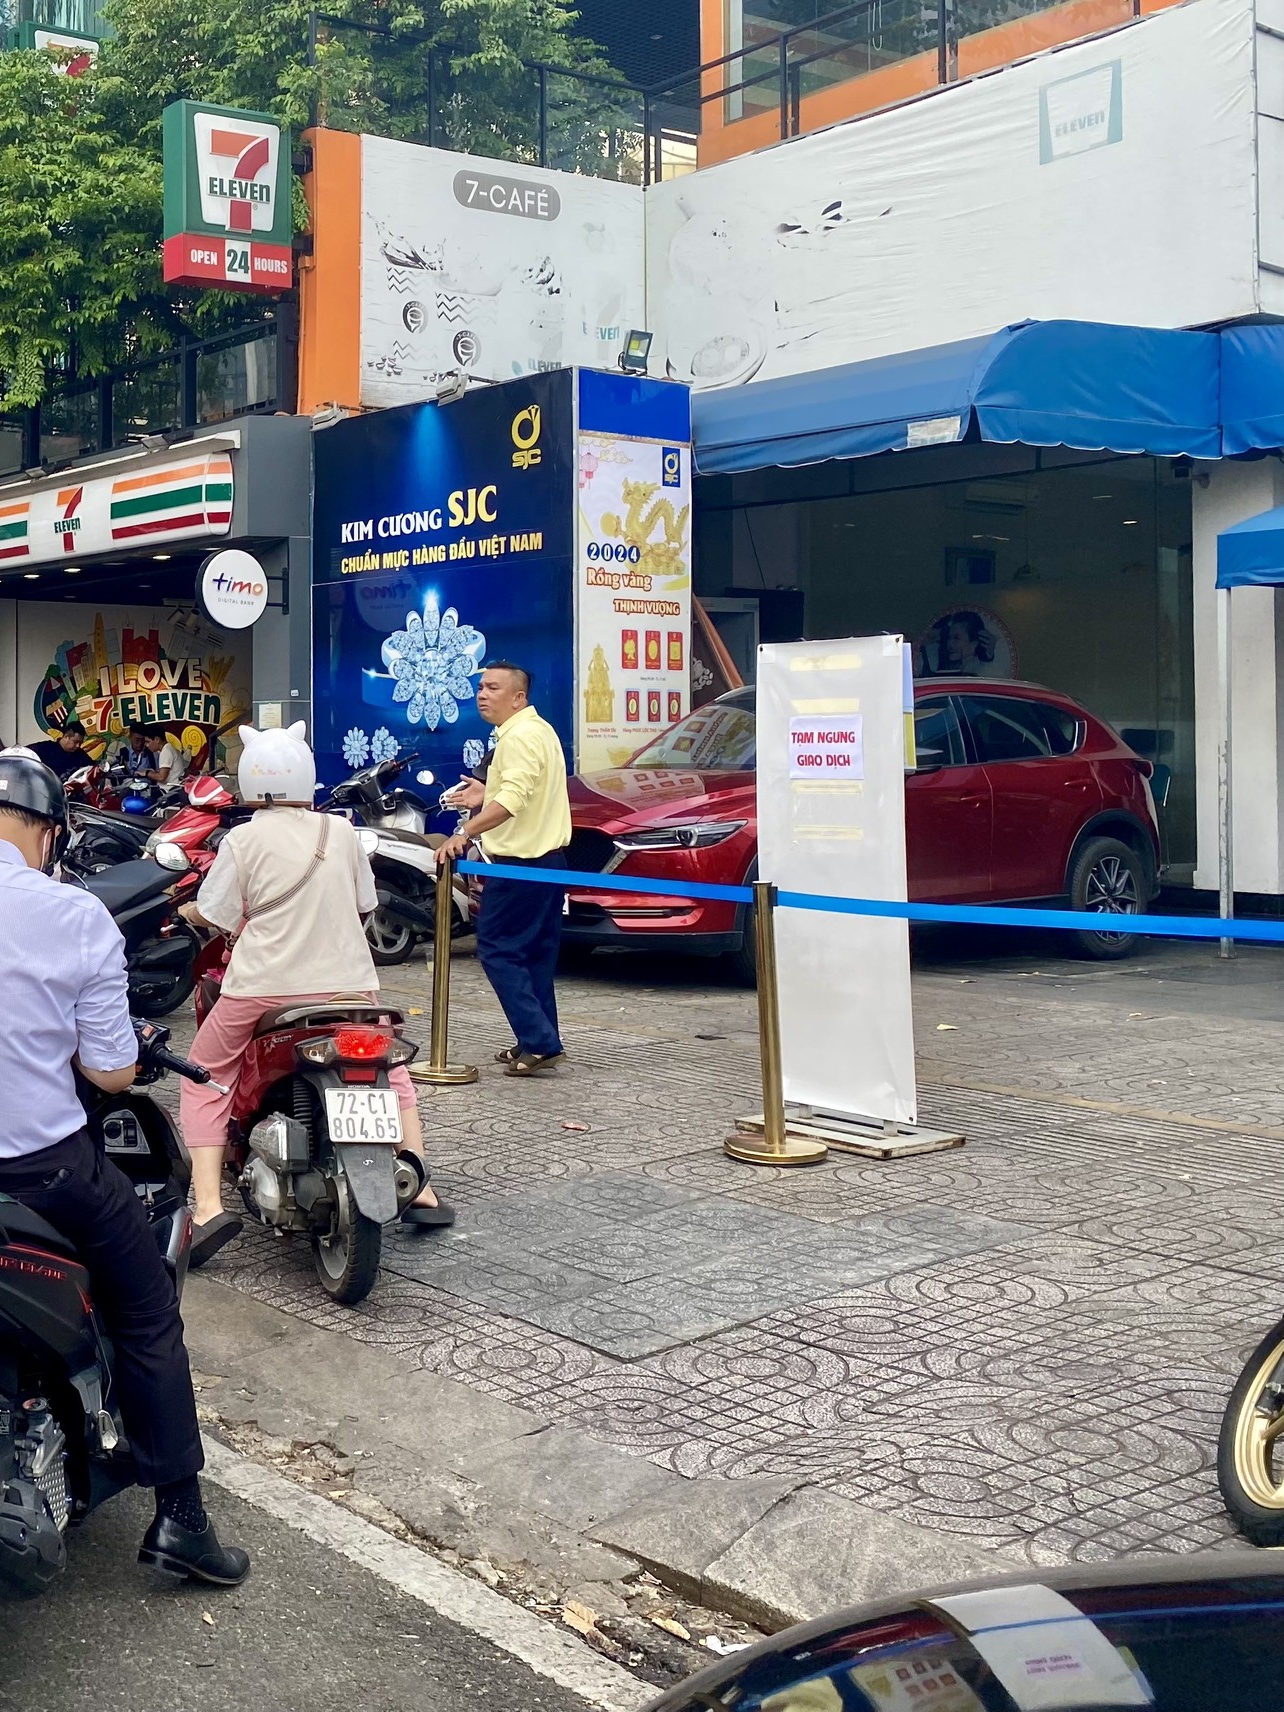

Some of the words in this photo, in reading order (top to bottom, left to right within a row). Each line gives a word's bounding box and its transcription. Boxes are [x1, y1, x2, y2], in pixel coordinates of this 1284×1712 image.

[465, 179, 549, 217] 7-CAFÉ
[190, 248, 218, 266] OPEN
[227, 248, 250, 274] 24
[254, 257, 288, 274] HOURS
[341, 520, 373, 543] KIM
[378, 508, 442, 538] CƯƠNG
[448, 485, 497, 527] SJC
[341, 549, 379, 574] CHUẨN
[383, 553, 409, 571] MỰC
[413, 545, 446, 565] HÀNG
[449, 537, 475, 560] ĐẦU
[478, 536, 506, 558] VIỆT
[510, 532, 542, 551] NAM
[587, 542, 641, 563] 2024
[212, 573, 264, 596] timo
[100, 666, 111, 697] I
[116, 659, 202, 694] LOVE
[791, 731, 814, 747] TẠM
[797, 754, 823, 766] GIAO
[826, 754, 851, 770] DỊCH
[336, 1092, 387, 1115] 72-C1
[333, 1117, 398, 1139] 804.65
